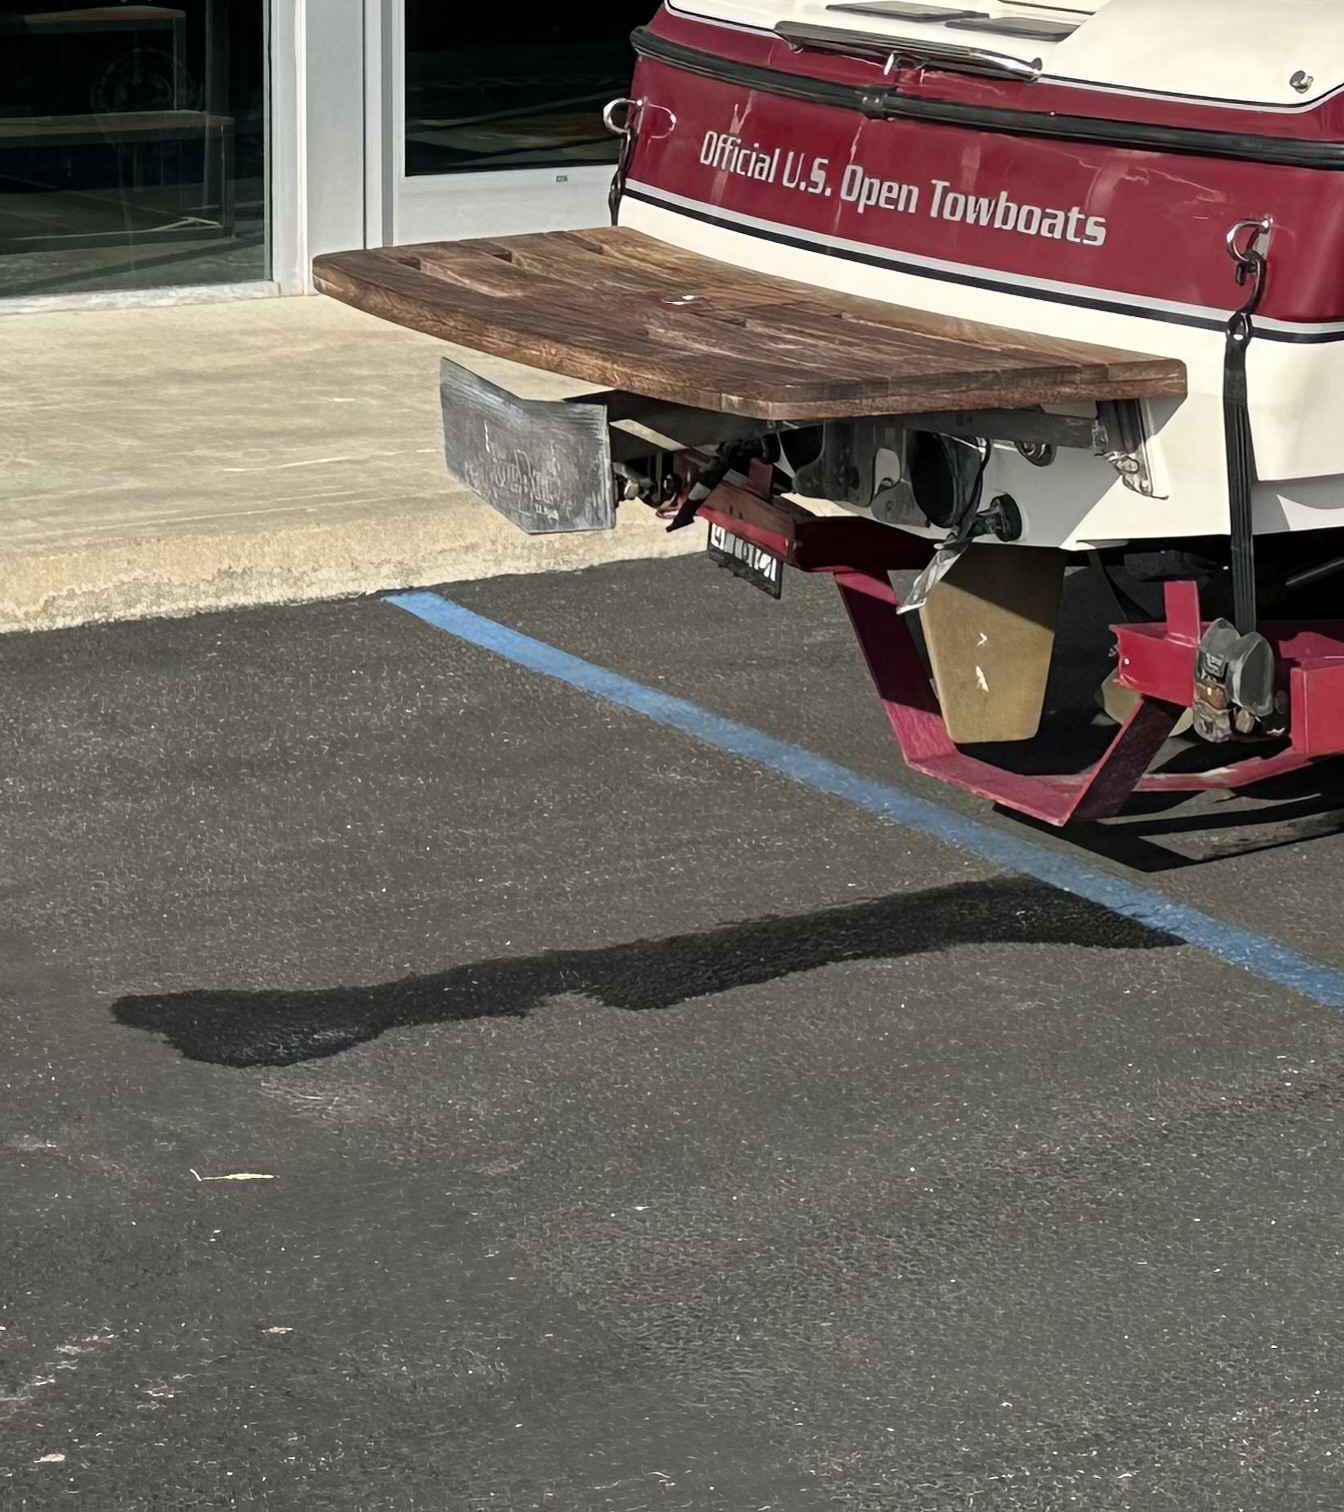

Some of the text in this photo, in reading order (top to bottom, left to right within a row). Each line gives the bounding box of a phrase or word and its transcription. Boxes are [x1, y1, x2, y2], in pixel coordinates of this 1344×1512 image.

[699, 130, 1108, 247] Official U.S. Open Towboats
